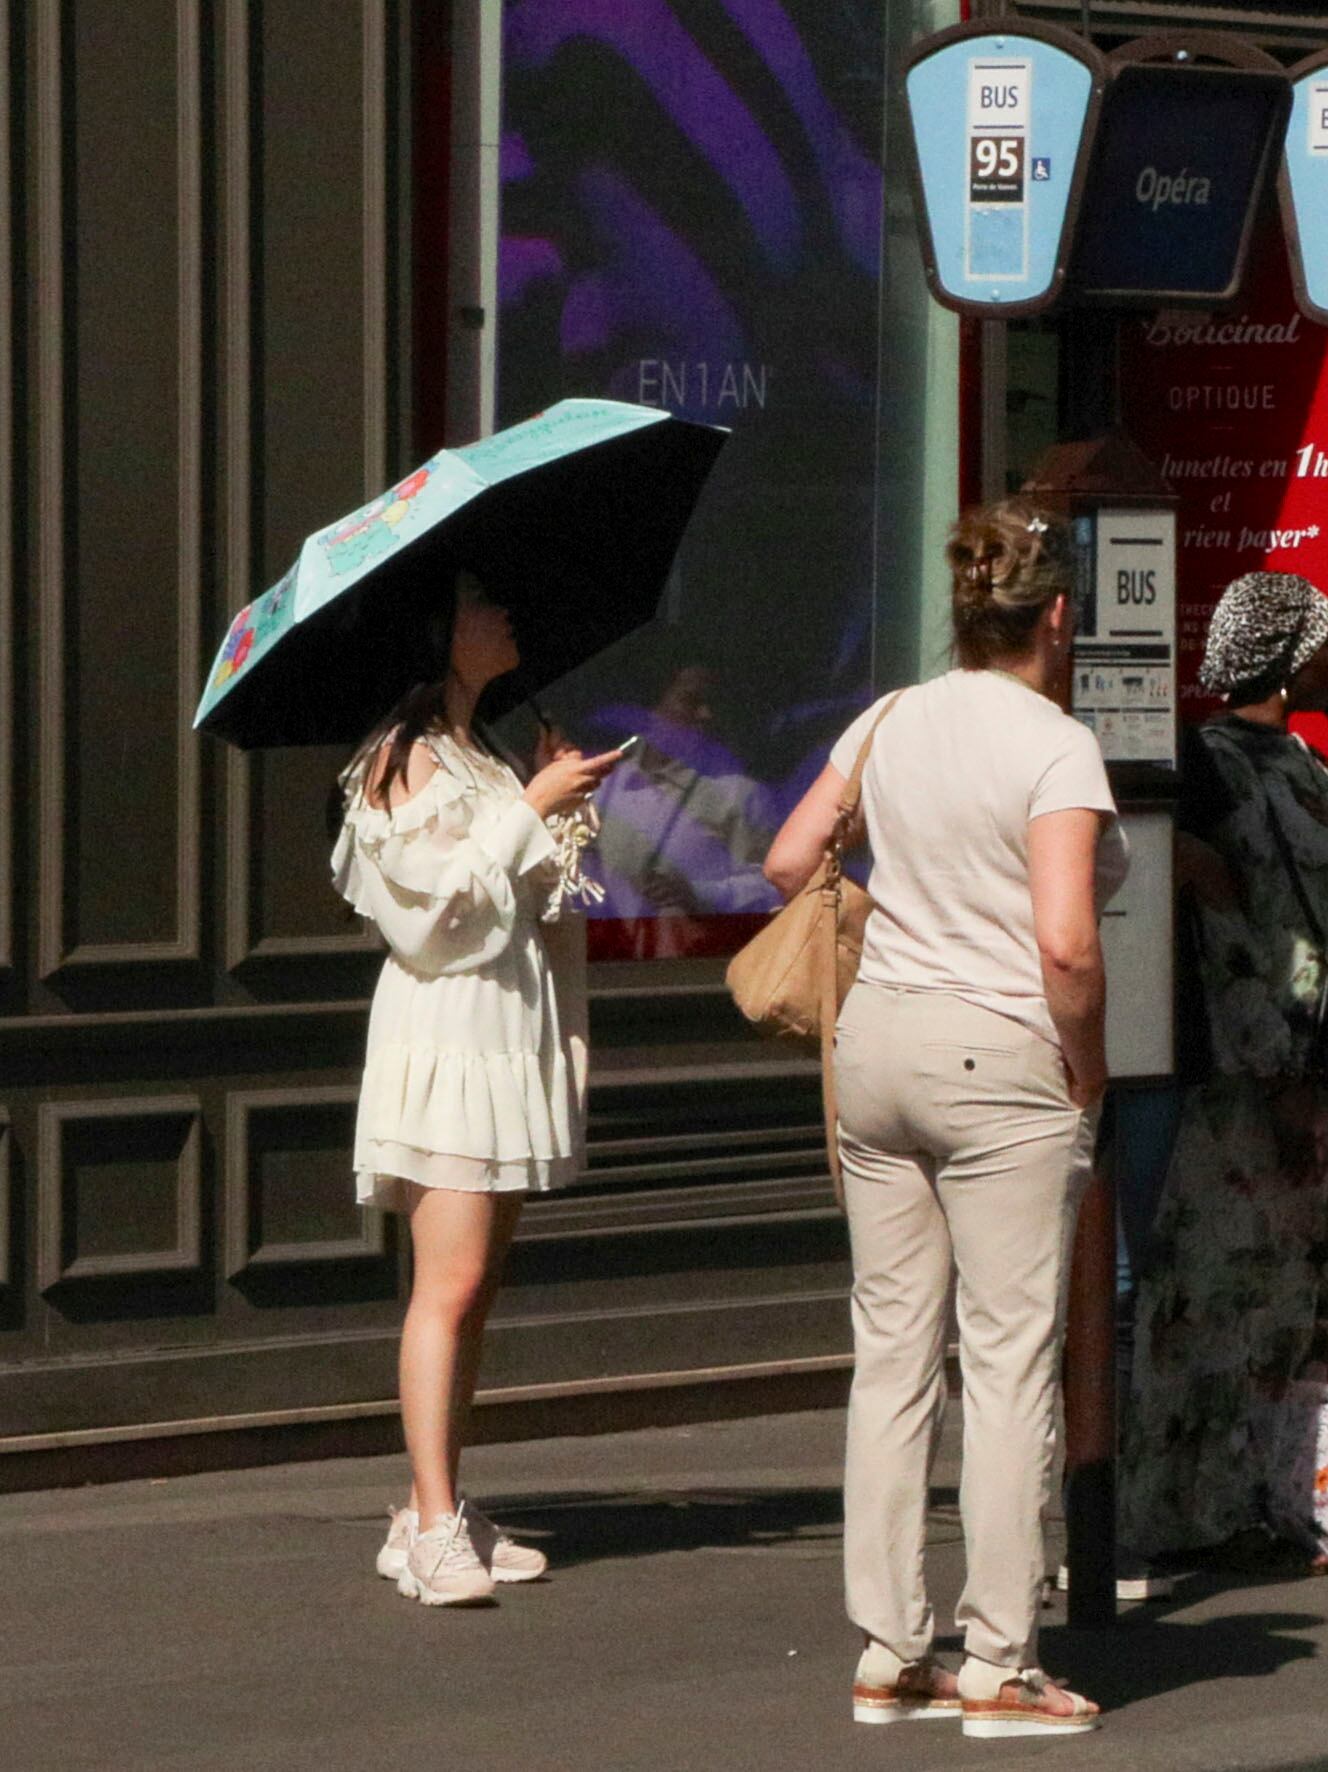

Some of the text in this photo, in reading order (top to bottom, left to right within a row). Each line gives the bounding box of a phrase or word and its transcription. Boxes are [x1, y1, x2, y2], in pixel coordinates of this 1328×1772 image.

[980, 86, 1018, 109] BUS
[975, 140, 1018, 177] 95
[1135, 167, 1210, 212] Opéra
[639, 359, 767, 409] EN 1 AN
[1169, 384, 1276, 410] OPTIQUE
[1160, 453, 1252, 478] lunettes
[1258, 461, 1288, 478] en
[1210, 491, 1232, 513] et
[1183, 524, 1231, 548] rien
[1117, 569, 1156, 605] BUS
